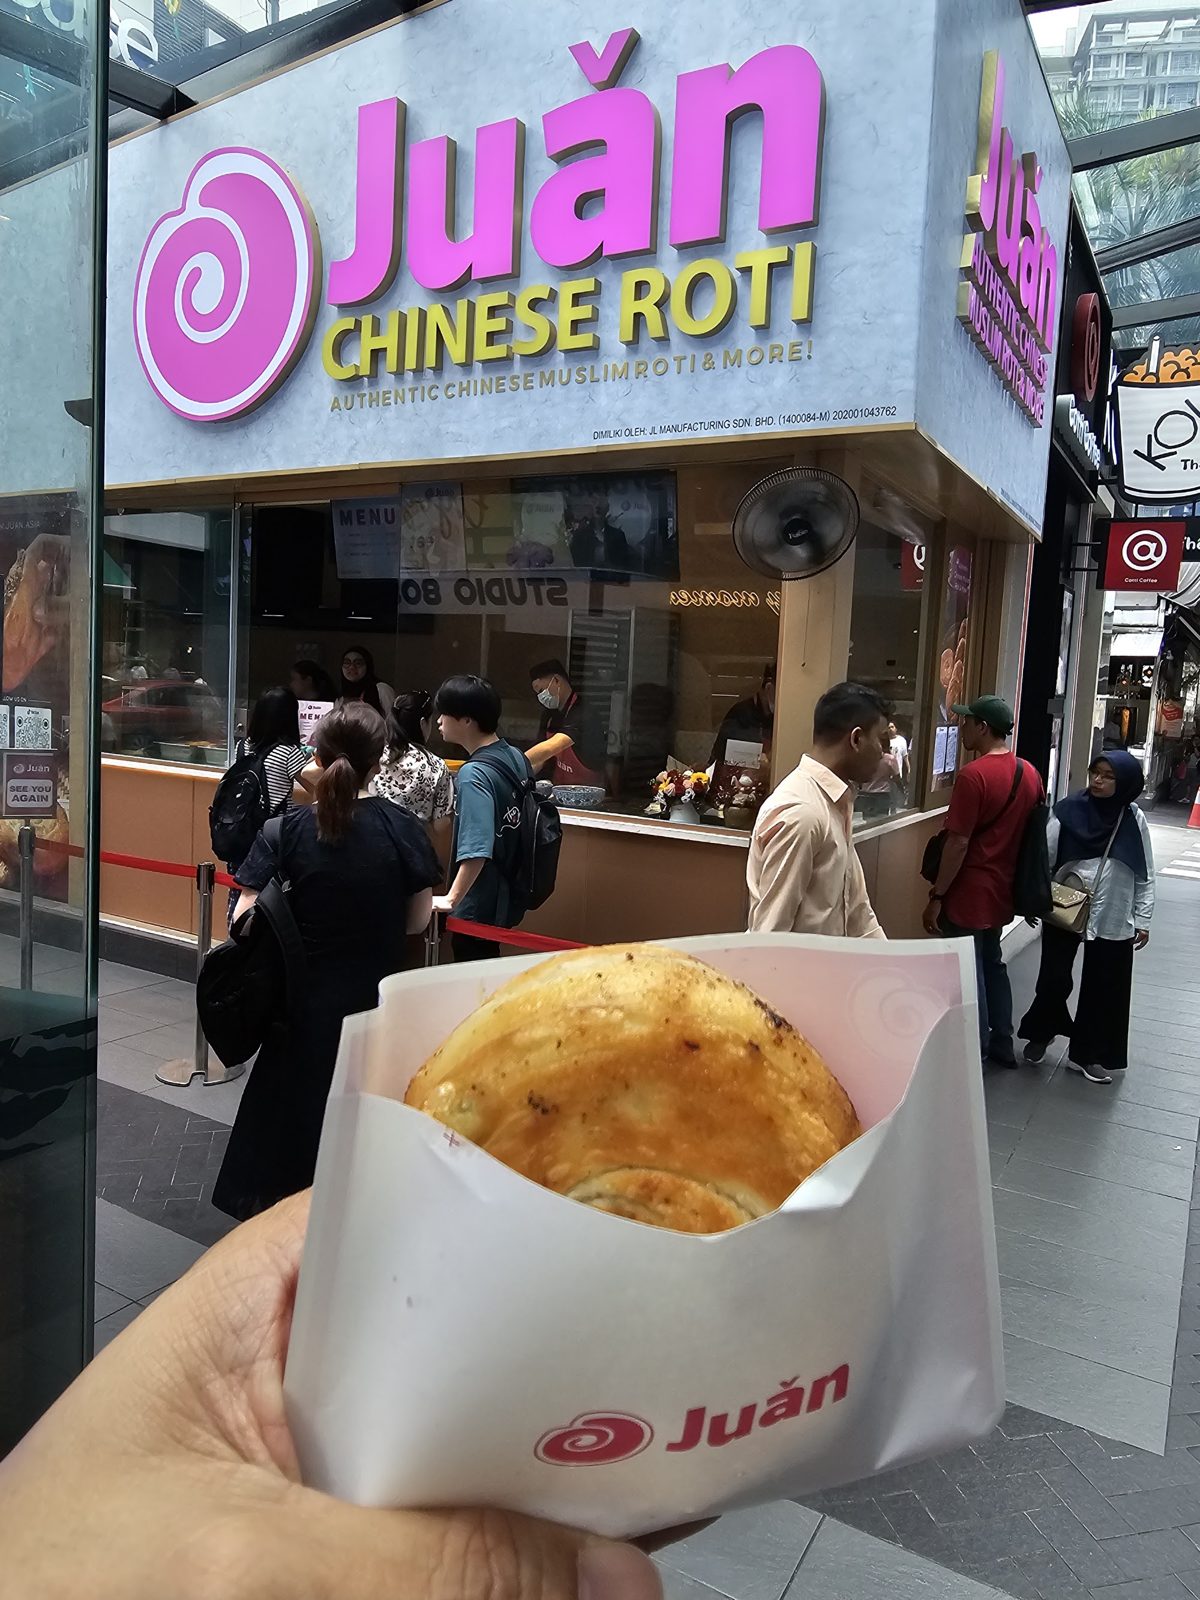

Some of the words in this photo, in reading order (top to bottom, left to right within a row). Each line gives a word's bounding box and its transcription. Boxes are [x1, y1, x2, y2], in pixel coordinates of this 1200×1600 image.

[321, 276, 601, 380] CHINESE
[619, 241, 817, 347] ROTI
[330, 384, 439, 412] AUTHENTIC
[444, 372, 535, 399] CHINESE
[539, 361, 629, 388] MUSLIM
[634, 353, 696, 379] ROTI
[701, 351, 716, 370] &
[722, 340, 814, 369] MORE!
[593, 429, 623, 440] DIMILIKI
[624, 427, 647, 438] OLEH:
[649, 425, 658, 436] JL
[659, 419, 731, 434] MANUFACTURING
[732, 417, 753, 429] SDN.
[755, 416, 776, 427] BHD.
[778, 410, 831, 426] (1400084-M)
[833, 405, 897, 421] 202001043762
[1181, 459, 1200, 471] Th
[340, 507, 396, 526] MENU
[9, 785, 28, 793] SEE
[31, 785, 52, 793] YOU
[11, 794, 49, 802] AGAIN
